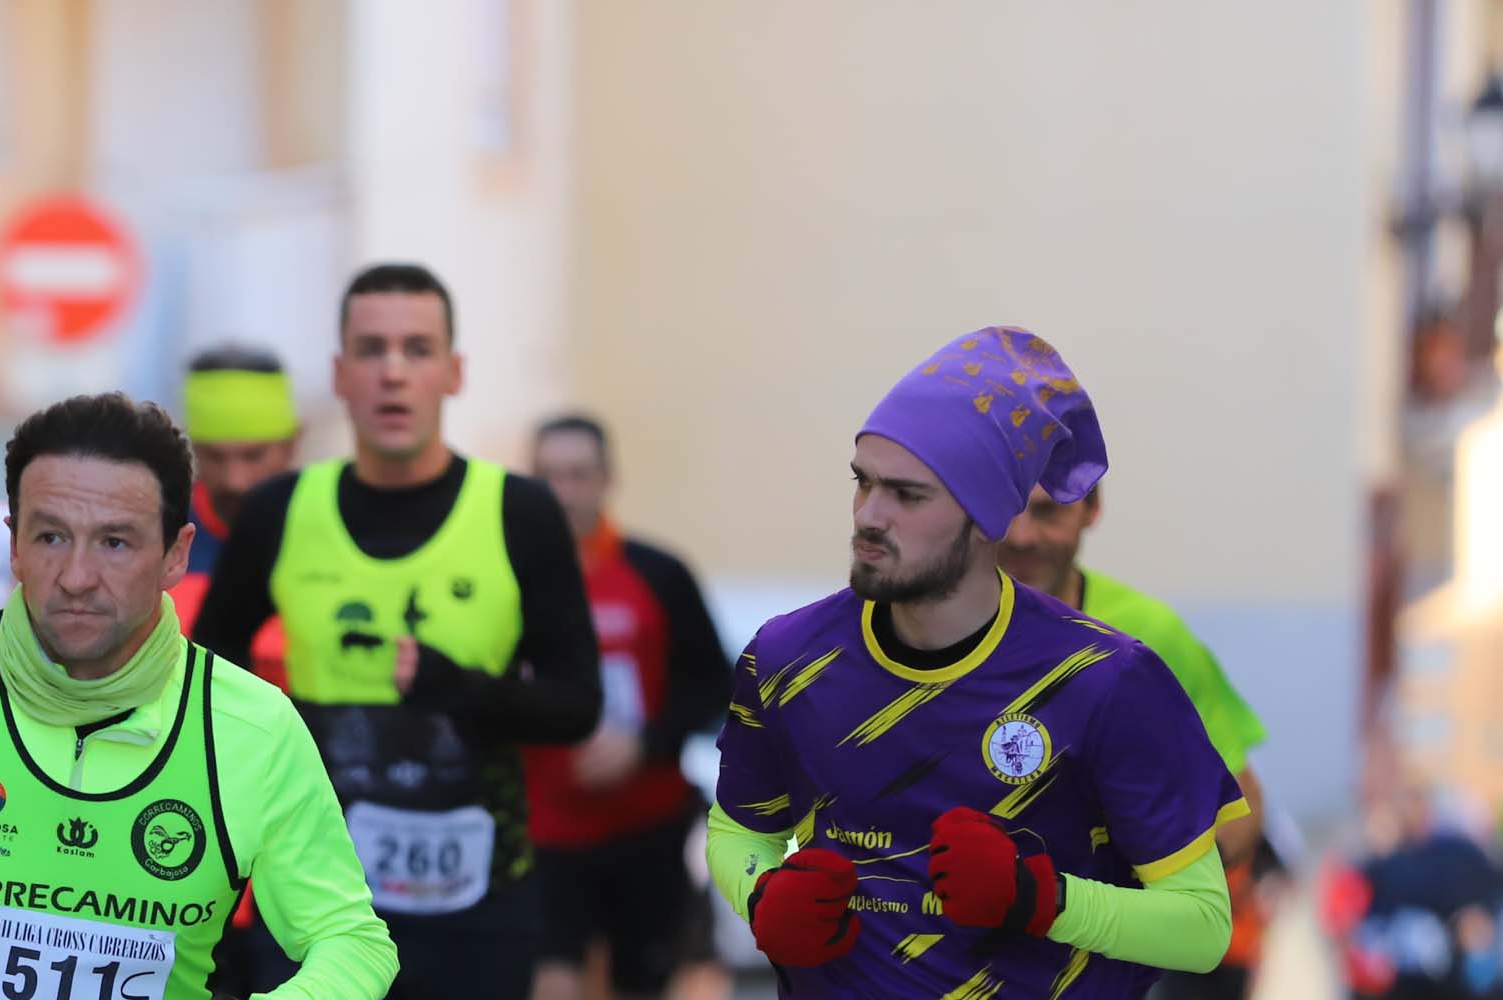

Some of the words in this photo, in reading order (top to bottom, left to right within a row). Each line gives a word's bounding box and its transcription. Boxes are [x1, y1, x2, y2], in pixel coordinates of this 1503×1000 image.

[139, 802, 202, 832] CORRECAMINOS
[826, 820, 892, 849] Jamón
[375, 836, 462, 877] 260
[848, 896, 909, 913] Atletismo
[14, 921, 43, 945] LIGA
[46, 928, 87, 951] CROSS
[89, 933, 167, 961] CABRERIZOS
